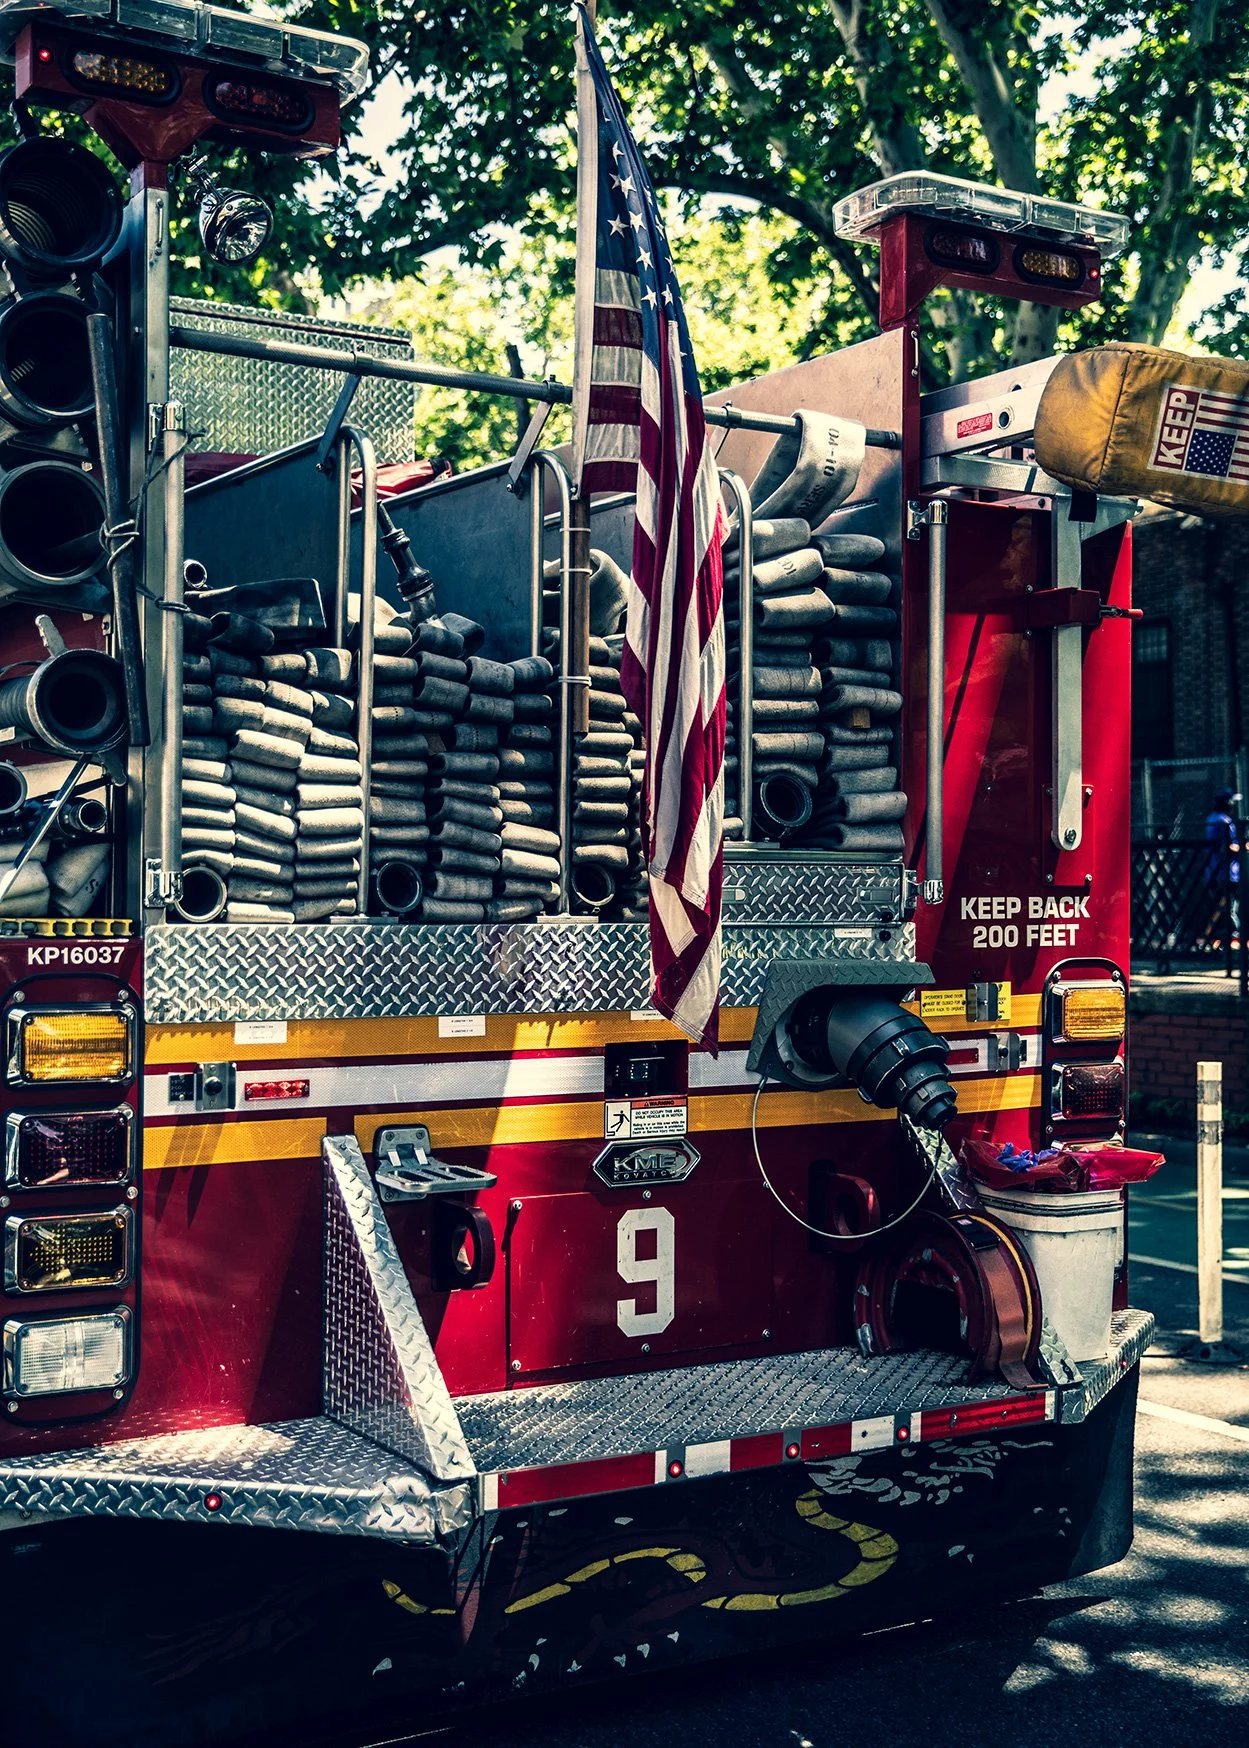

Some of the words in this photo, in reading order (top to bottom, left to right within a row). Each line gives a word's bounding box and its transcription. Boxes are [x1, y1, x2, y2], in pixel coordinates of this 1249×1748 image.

[1157, 391, 1195, 465] KEEP
[961, 897, 1022, 920] KEEP
[1028, 896, 1091, 919] BACK
[973, 925, 1019, 948] 200
[1026, 923, 1080, 947] FEET
[27, 946, 125, 965] KP16037
[614, 1153, 677, 1171] KME
[617, 1206, 675, 1337] 9
